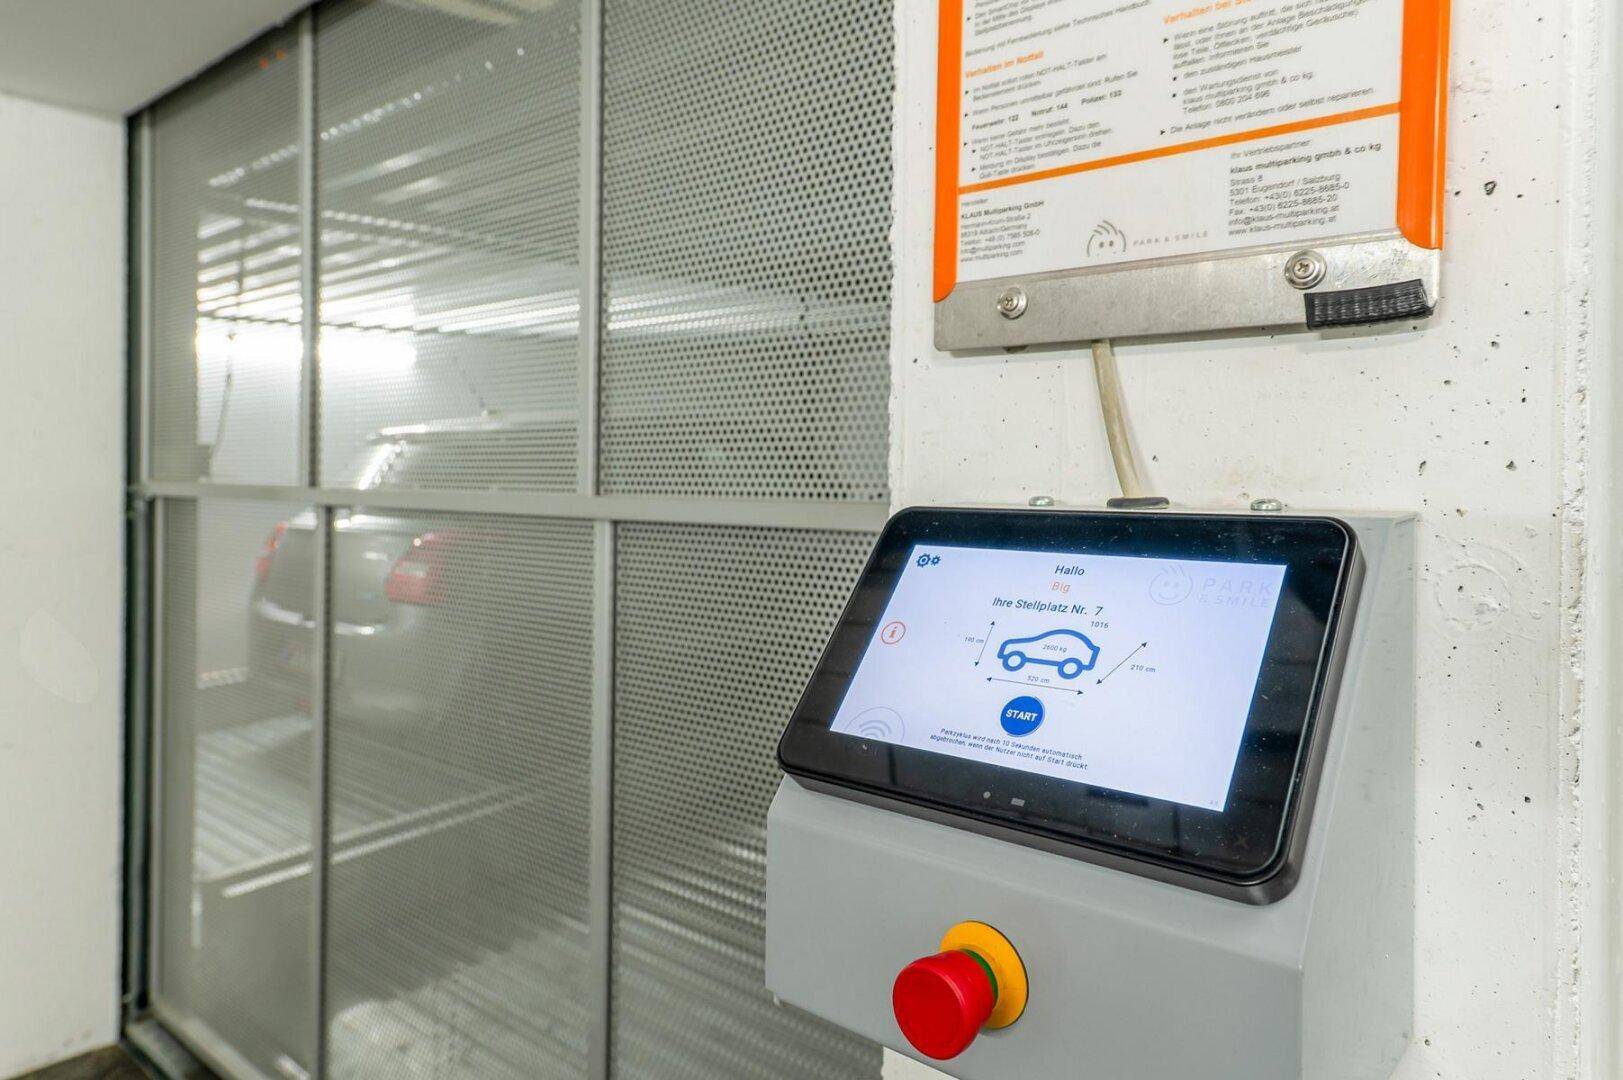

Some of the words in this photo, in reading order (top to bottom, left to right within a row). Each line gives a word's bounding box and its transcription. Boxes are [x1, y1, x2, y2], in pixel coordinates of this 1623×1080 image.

[1164, 4, 1212, 24] Verhalten
[966, 62, 1002, 78] Verhalten
[1004, 60, 1014, 68] im
[1016, 51, 1044, 65] Notfall
[1056, 101, 1068, 110] 144
[1170, 125, 1183, 134] Die
[1186, 119, 1211, 132] Anlage
[1214, 115, 1232, 125] nicht
[1230, 163, 1253, 174] klaus
[1255, 154, 1312, 171] multiparking
[1314, 149, 1342, 161] gmbh
[1354, 146, 1366, 154] co
[1369, 142, 1381, 153] kg
[1252, 180, 1295, 195] Eugendorf
[1303, 172, 1341, 186] Salzburg
[962, 209, 981, 219] KLAUS
[984, 202, 1022, 217] Multiparking
[1024, 199, 1045, 209] GmbH
[1054, 565, 1085, 576] Hallo
[1051, 581, 1071, 594] Big
[1202, 578, 1273, 594] PARK
[992, 597, 1013, 608] Ihre
[1015, 598, 1068, 613] Stellplatz
[1070, 604, 1088, 615] Nr.
[1095, 606, 1104, 616] 7
[1090, 620, 1109, 629] 1016
[1042, 644, 1059, 652] 2600
[1059, 646, 1068, 654] kg
[1130, 664, 1144, 672] 210
[1026, 675, 1040, 683] 520
[1005, 709, 1038, 722] START
[940, 728, 971, 740] Parkzyklus
[972, 734, 985, 742] wird
[986, 736, 1000, 744] nach
[1011, 742, 1041, 752] Sekunden
[1042, 748, 1082, 760] automatisch
[996, 746, 1016, 755] Nutzer
[1017, 751, 1033, 759] nicht
[1034, 754, 1046, 762] auf
[1046, 756, 1064, 765] Start
